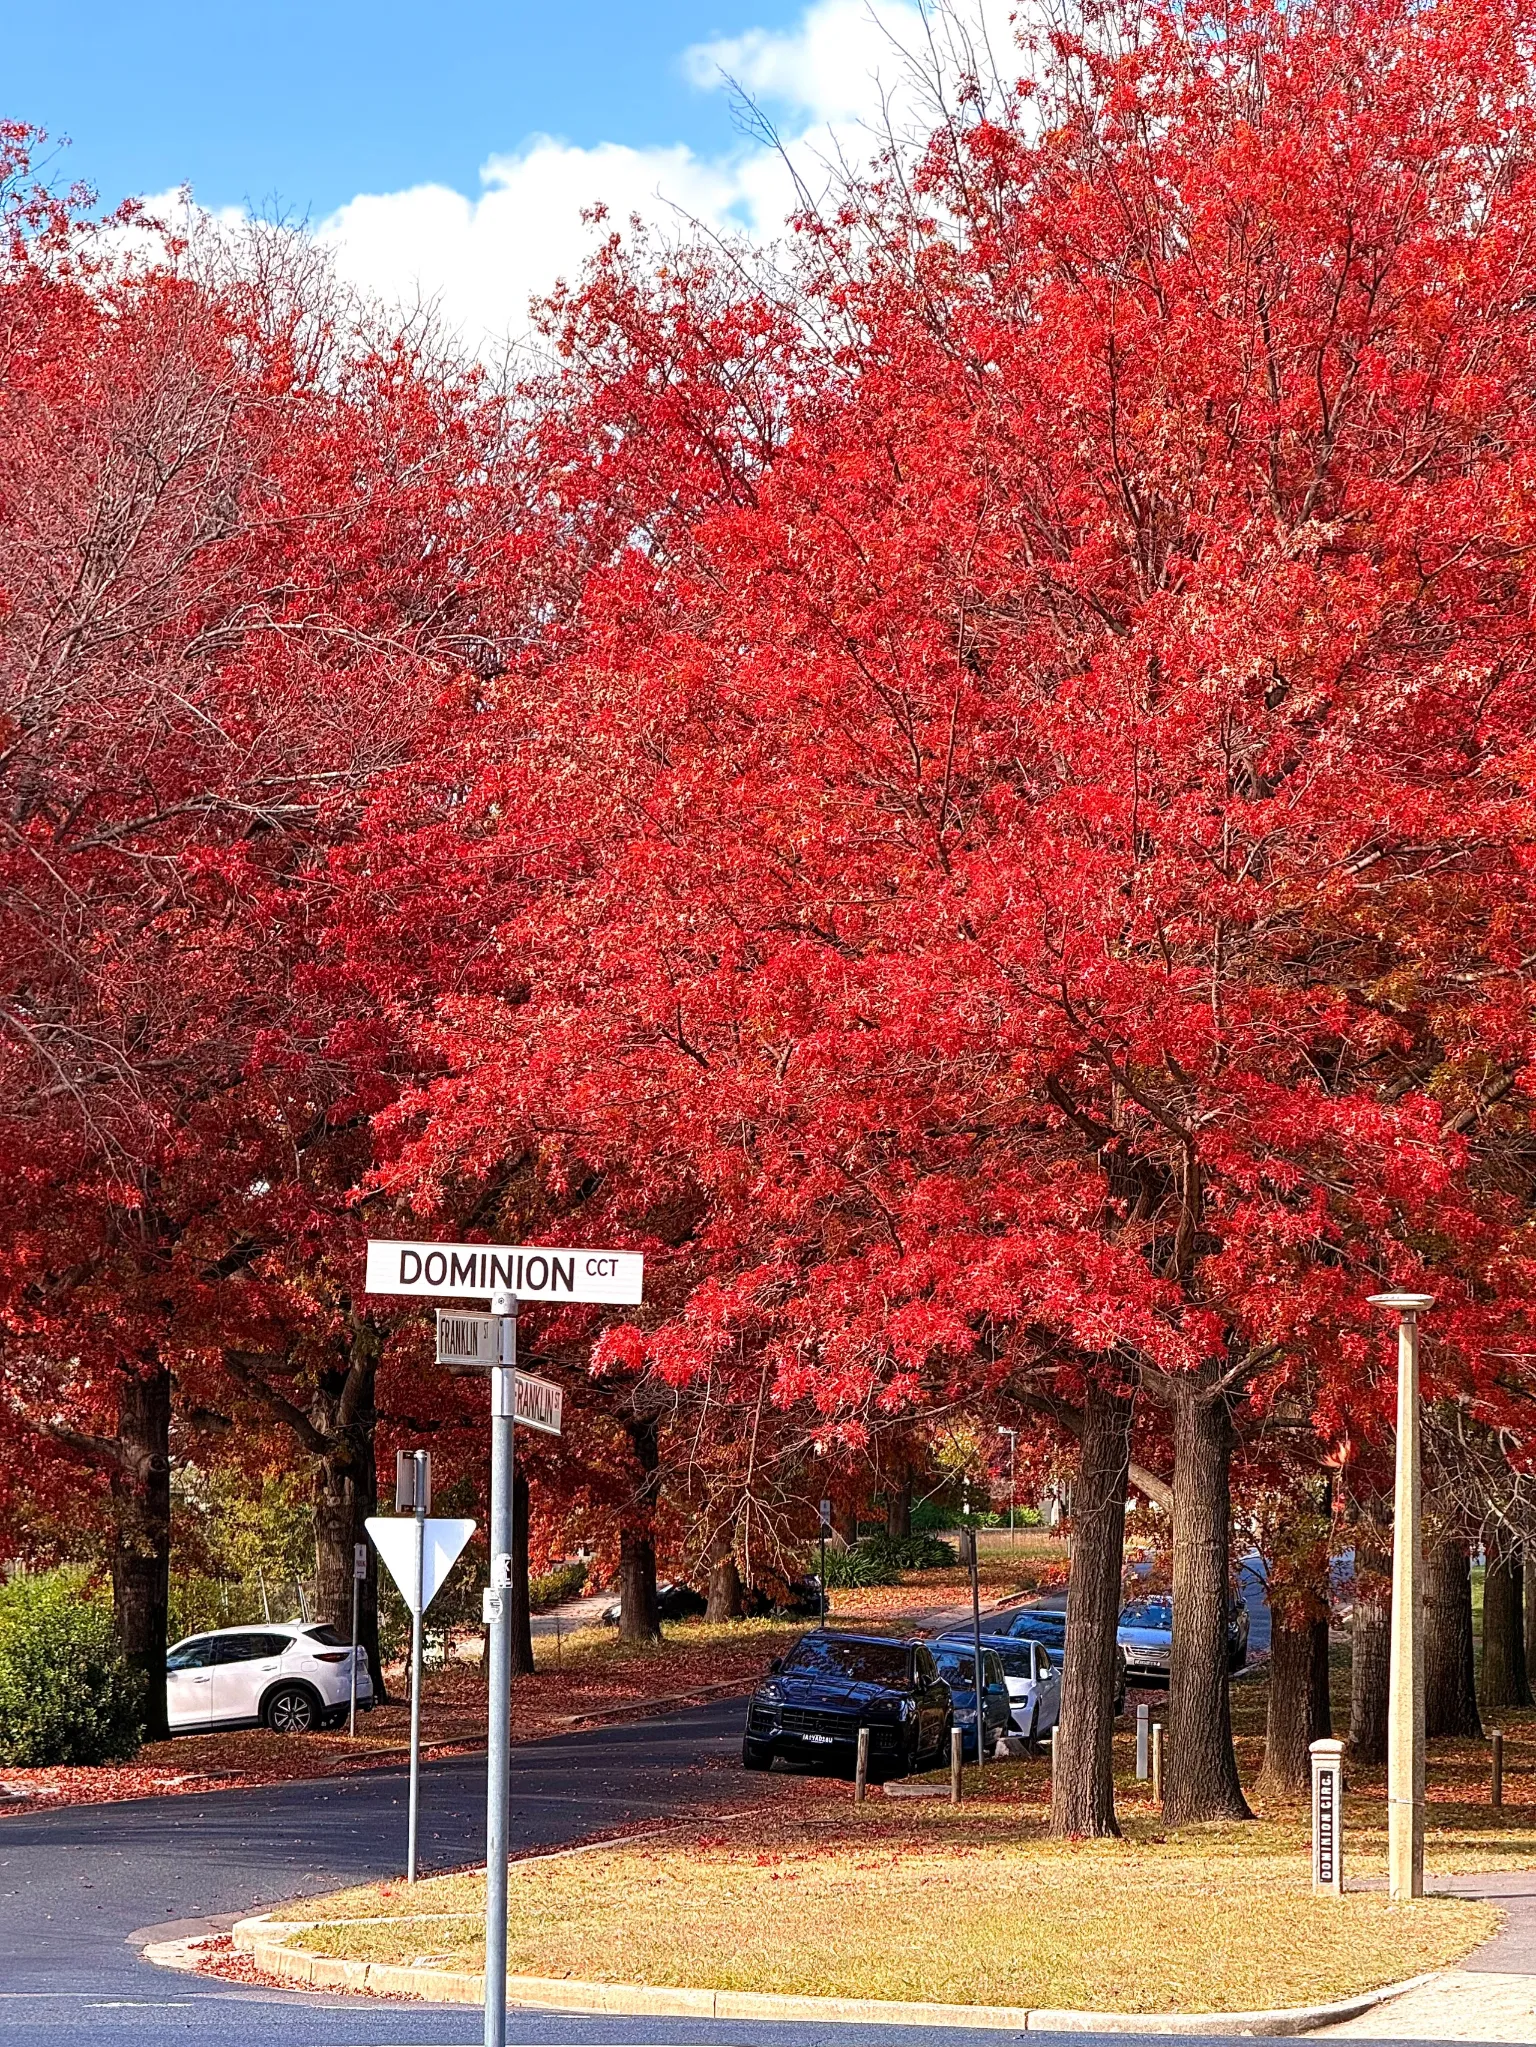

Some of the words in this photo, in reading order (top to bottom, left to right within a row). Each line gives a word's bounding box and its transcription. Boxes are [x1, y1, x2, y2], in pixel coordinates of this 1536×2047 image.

[400, 1250, 575, 1292] DOMINION
[586, 1259, 619, 1277] CCT
[440, 1318, 478, 1356] FRANKLIN
[483, 1321, 489, 1339] ST
[554, 1391, 561, 1410] ST
[1321, 1775, 1332, 1809] CIRC.
[1321, 1813, 1332, 1879] DOMINION
